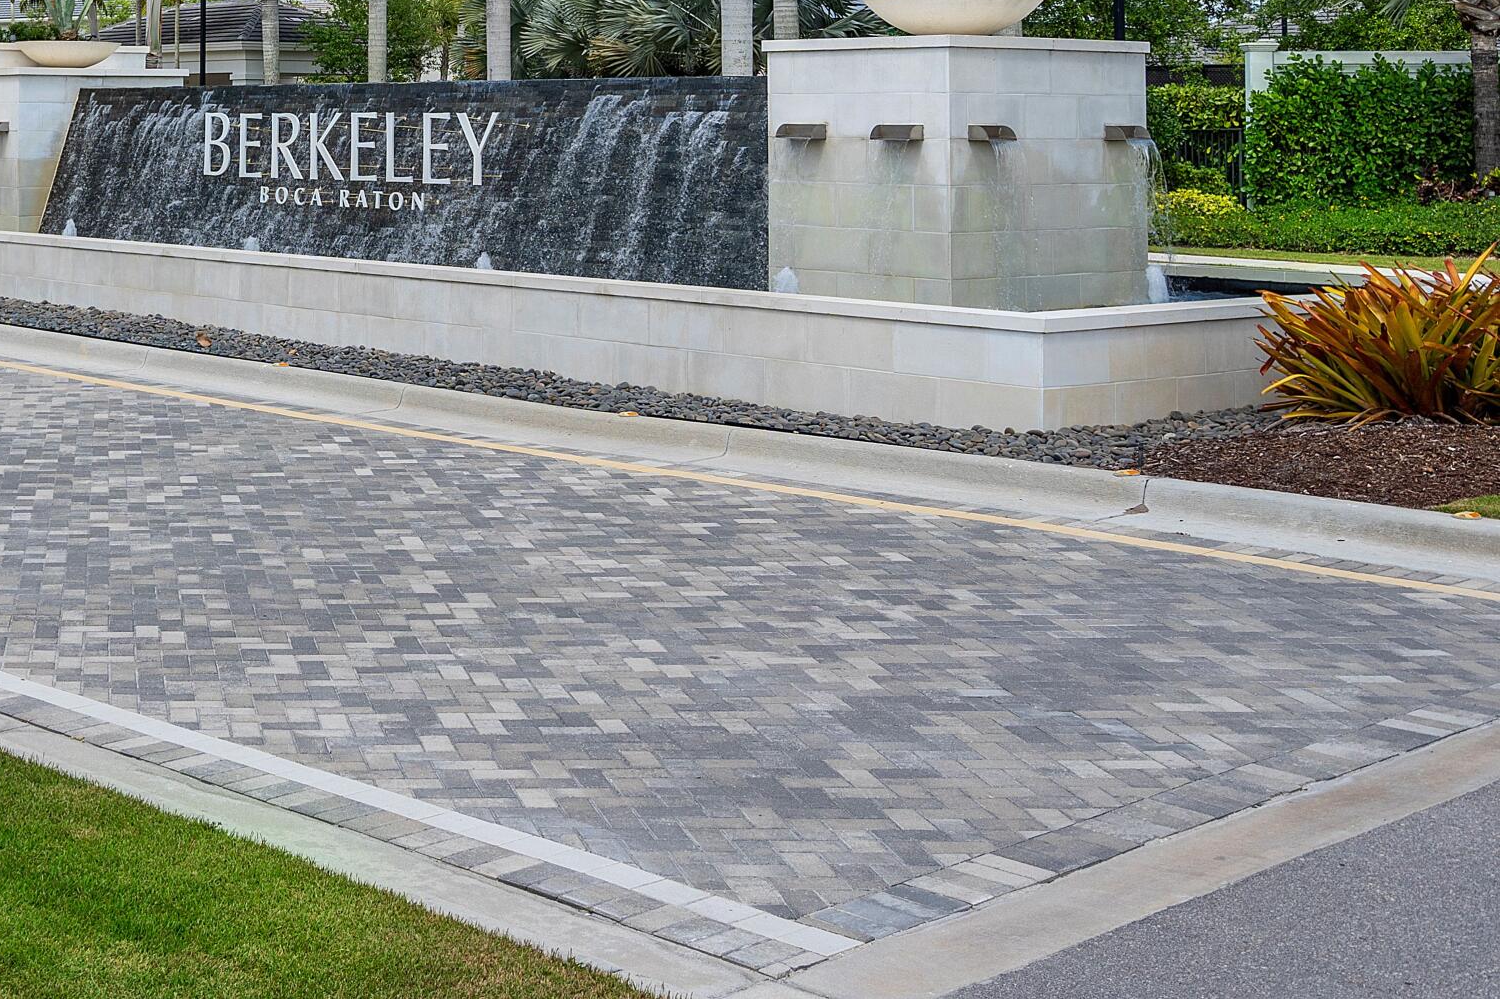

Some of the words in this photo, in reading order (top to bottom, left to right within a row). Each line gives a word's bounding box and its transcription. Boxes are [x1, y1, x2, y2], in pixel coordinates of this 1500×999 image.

[203, 111, 499, 186] BERKELEY
[259, 186, 323, 207] BOCA
[339, 189, 425, 211] RATON
